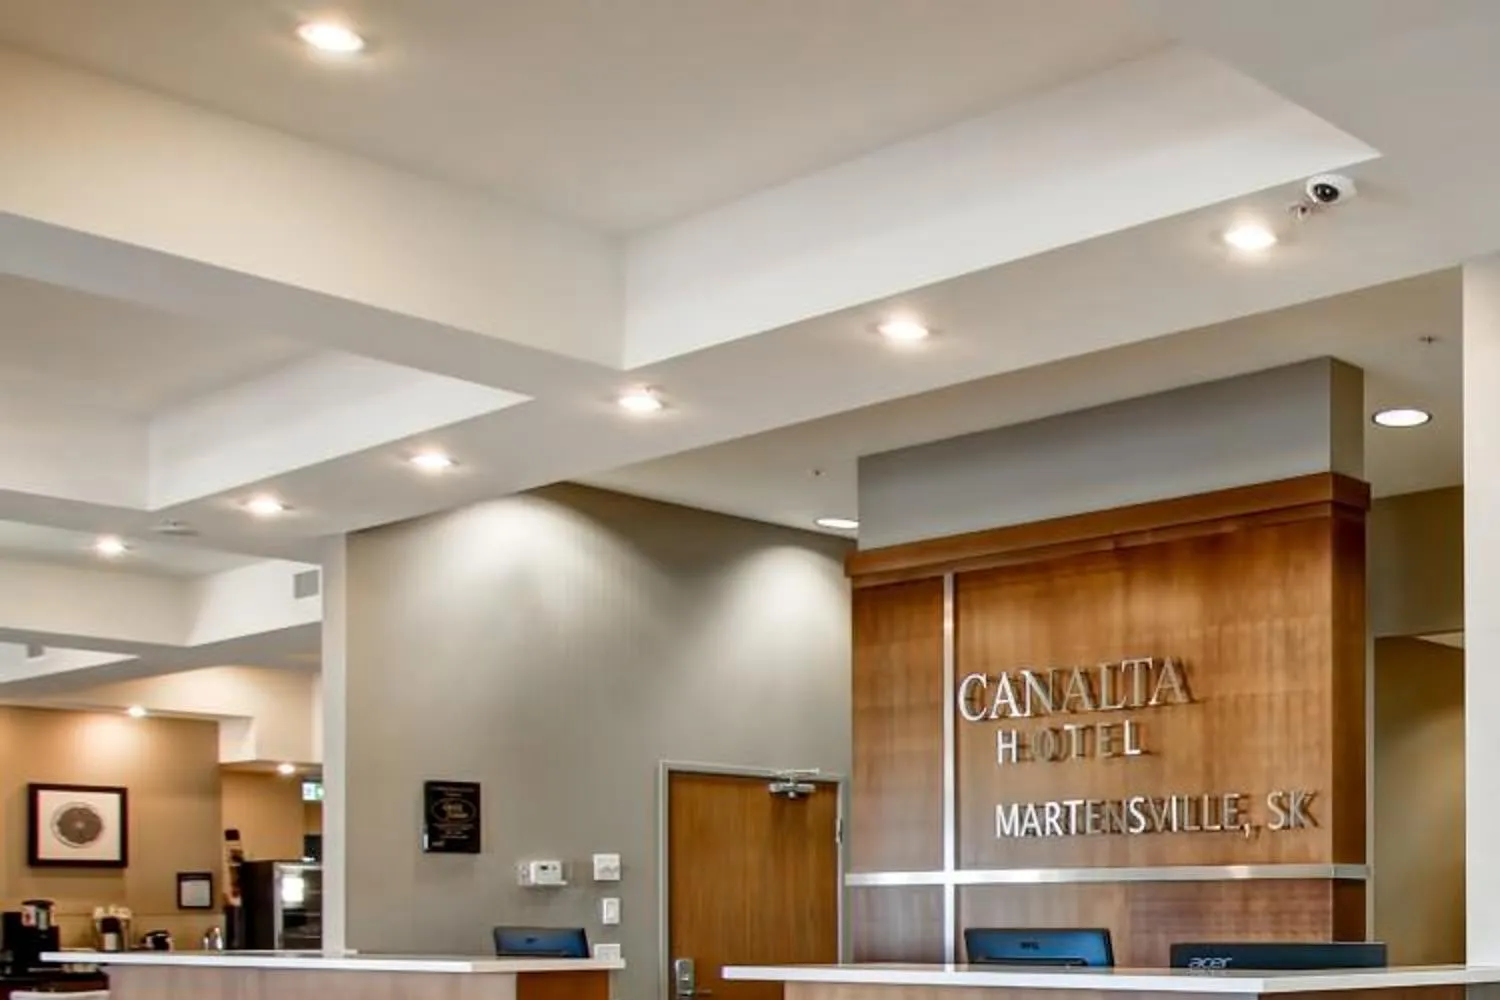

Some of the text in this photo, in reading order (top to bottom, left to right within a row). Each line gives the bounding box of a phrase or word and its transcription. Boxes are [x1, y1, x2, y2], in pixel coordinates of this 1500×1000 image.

[958, 656, 1192, 722] CANALTA
[997, 720, 1142, 763] HOTEL
[995, 790, 1318, 838] MARTENSVILLE, SK
[1188, 956, 1233, 969] acer
